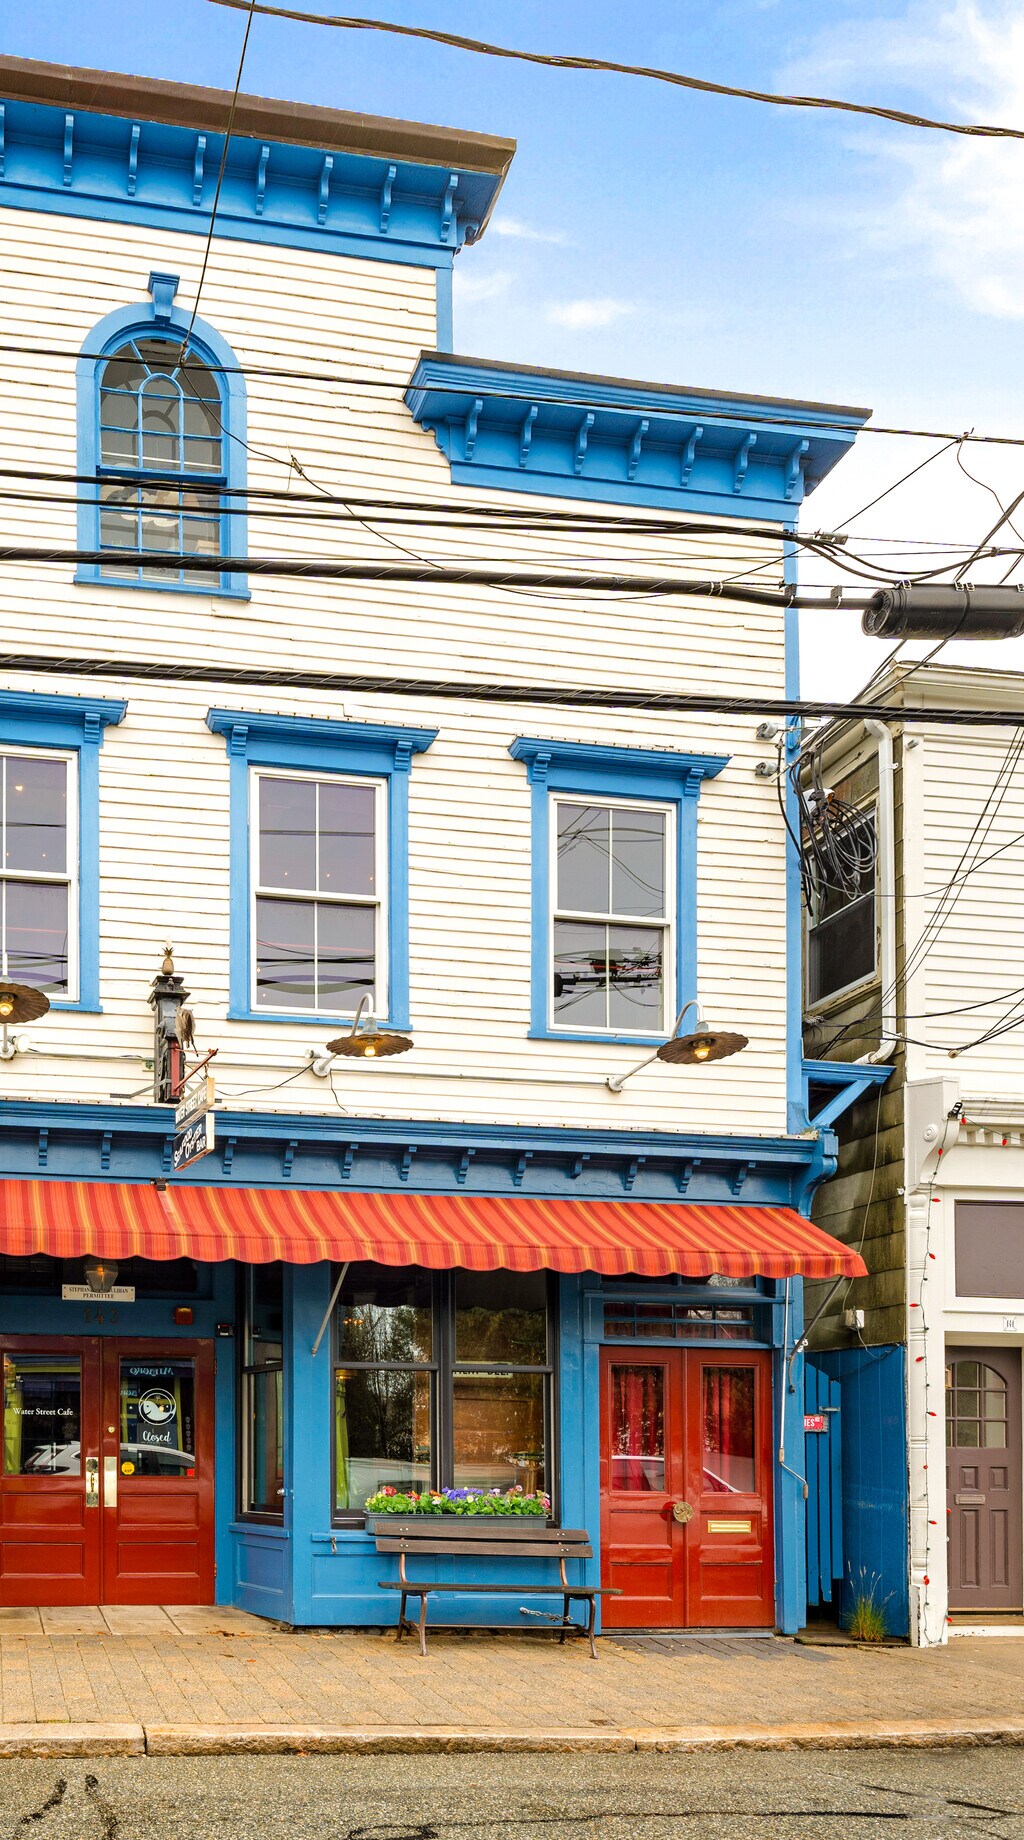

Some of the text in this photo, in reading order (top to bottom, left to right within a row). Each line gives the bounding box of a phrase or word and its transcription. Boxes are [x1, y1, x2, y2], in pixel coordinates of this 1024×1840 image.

[196, 1135, 206, 1152] BAR
[36, 1408, 56, 1416] Street
[57, 1408, 74, 1416] Cafe
[142, 1430, 171, 1442] Closed
